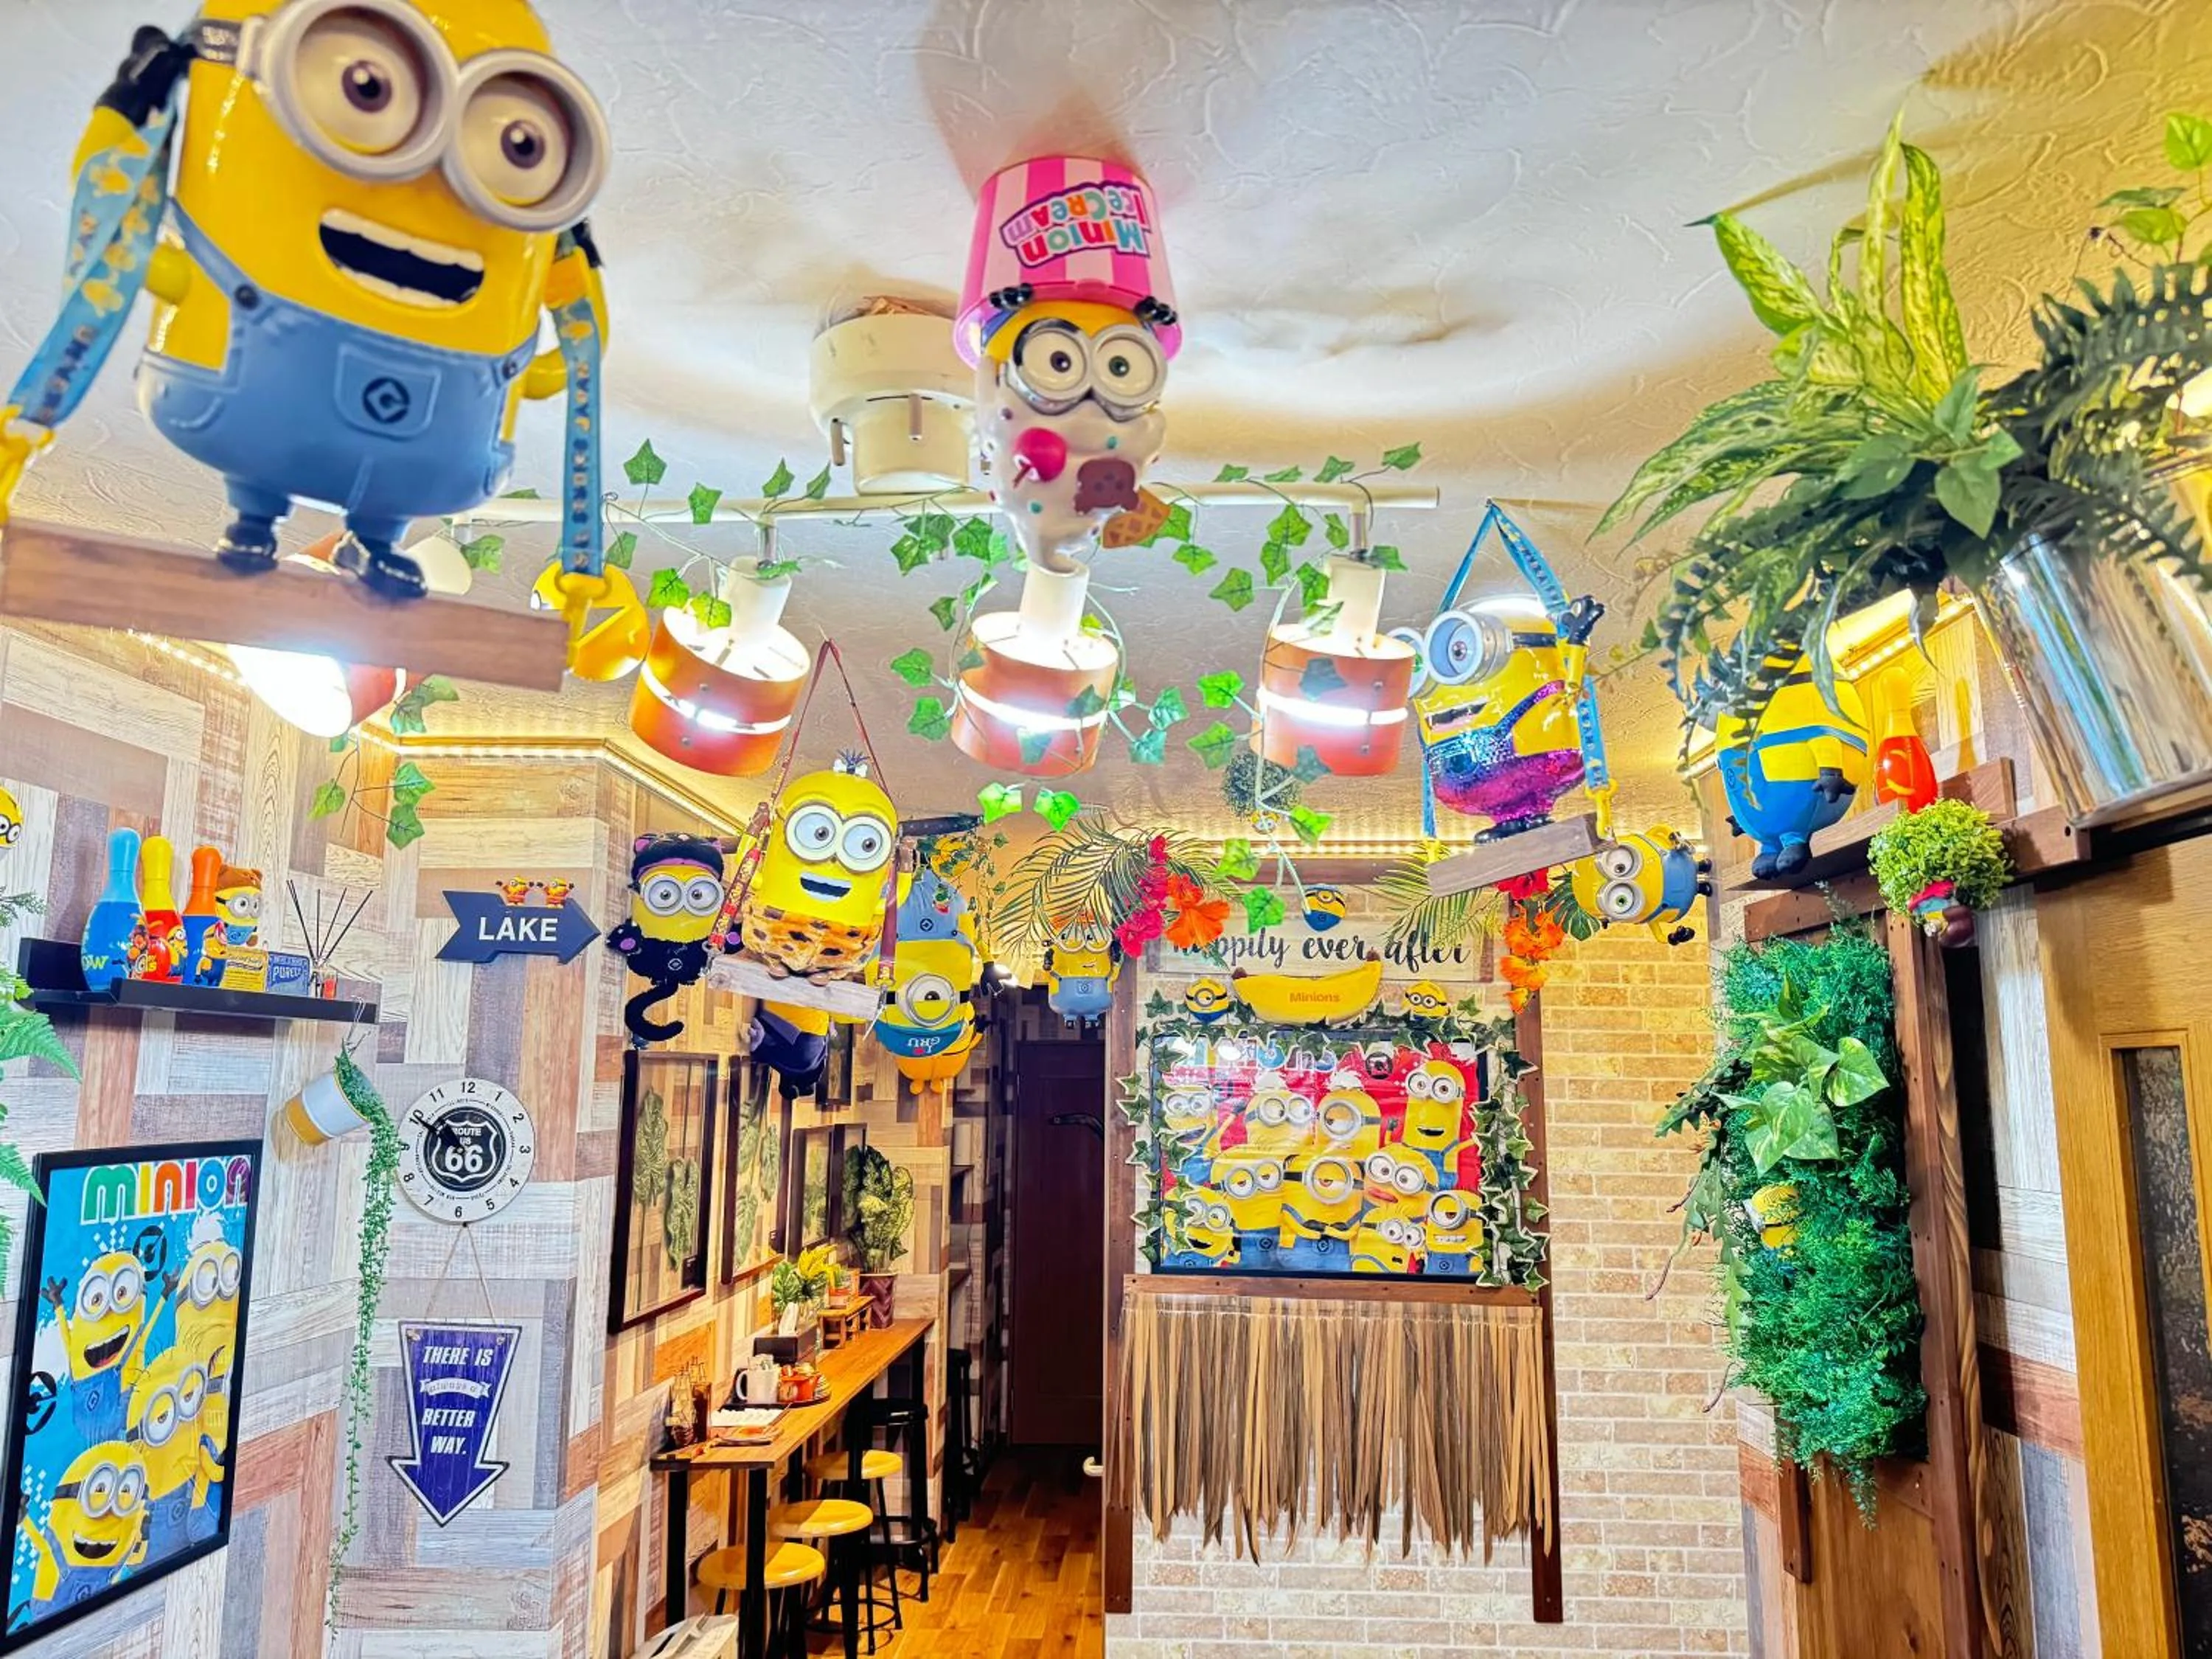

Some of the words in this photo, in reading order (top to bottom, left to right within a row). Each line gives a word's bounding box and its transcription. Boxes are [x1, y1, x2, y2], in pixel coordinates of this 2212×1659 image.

[479, 917, 559, 942] LAKE
[1302, 935, 1366, 961] ever
[1289, 991, 1341, 1004] Minions
[461, 1082, 476, 1093] 12
[429, 1088, 445, 1103] 11
[494, 1091, 503, 1102] 1
[409, 1110, 423, 1126] 10
[512, 1113, 524, 1123] 2
[518, 1145, 531, 1154] 3
[445, 1145, 483, 1172] 66
[403, 1172, 414, 1182] 8
[509, 1178, 519, 1187] 4
[423, 1194, 434, 1206] 7
[485, 1198, 495, 1210] 5
[454, 1206, 462, 1217] 6
[422, 1346, 470, 1366] THERE
[474, 1348, 493, 1366] IS
[421, 1408, 476, 1427] BETTER
[430, 1436, 467, 1455] WAY.
